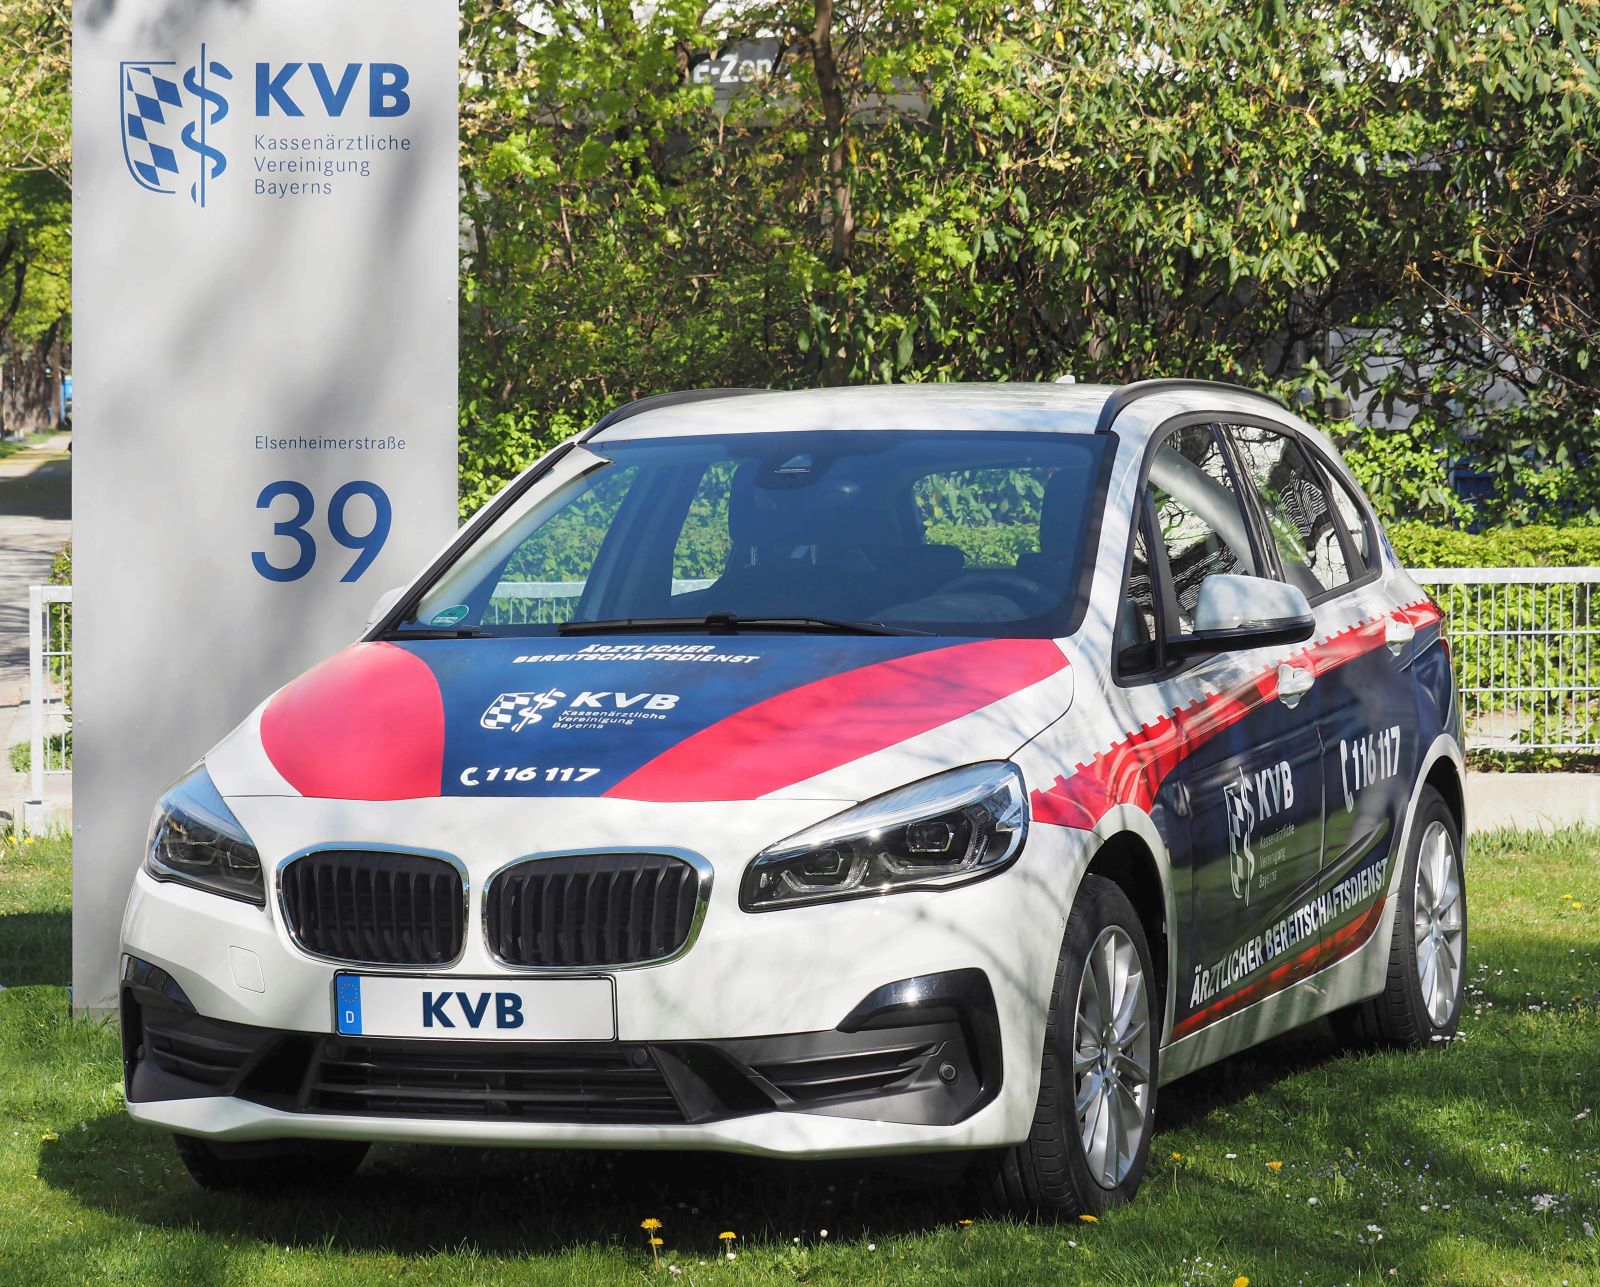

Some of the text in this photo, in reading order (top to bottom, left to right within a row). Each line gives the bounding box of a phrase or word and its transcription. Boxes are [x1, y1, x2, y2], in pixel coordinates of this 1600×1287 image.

[255, 62, 411, 118] KVB
[254, 134, 411, 151] Kassenärztliche
[254, 156, 370, 176] Vereinigung
[254, 179, 332, 199] Bayerns
[255, 435, 406, 450] Elsenheimerstraße
[251, 480, 392, 583] 39
[578, 643, 715, 653] ÄRZTLICHER
[512, 653, 760, 664] BEREITSCHAFTSDIENST
[569, 691, 680, 710] KVB
[558, 716, 634, 725] Vereinigung
[562, 709, 667, 720] Kassenärztliche
[1352, 725, 1401, 791] 116 117
[485, 767, 601, 781] 116 117
[1254, 760, 1294, 821] KVB
[1189, 857, 1388, 1009] ÄRZTLICHER BEREITSCHAFTSDIENST
[345, 991, 525, 1029] D KVB
